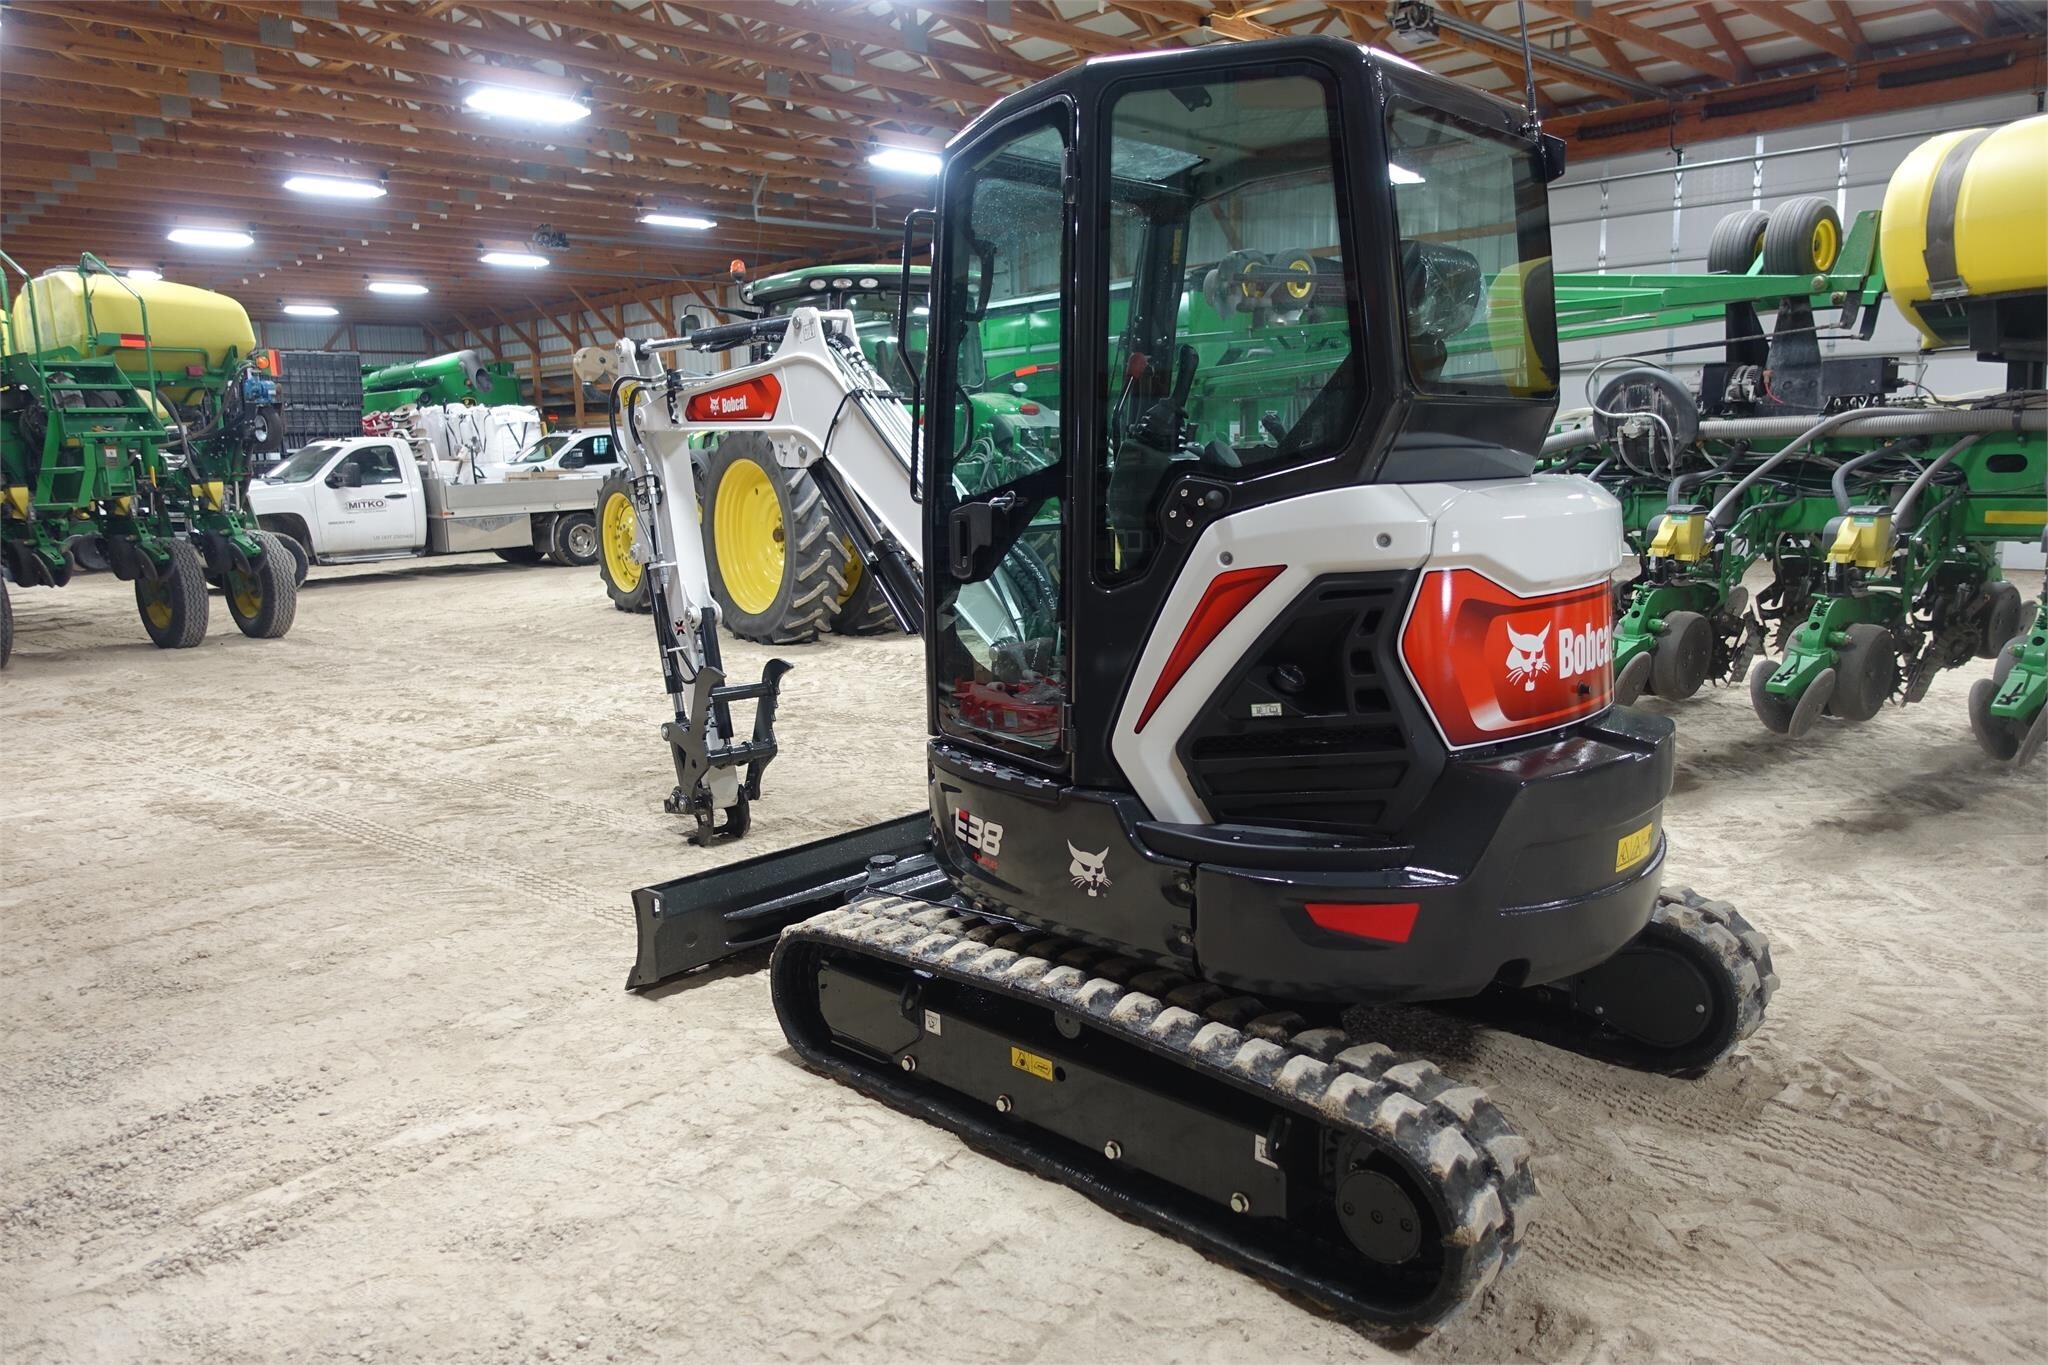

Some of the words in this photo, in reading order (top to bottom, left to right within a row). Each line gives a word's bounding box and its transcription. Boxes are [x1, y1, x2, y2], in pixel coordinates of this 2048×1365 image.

[721, 395, 748, 413] Bobcat
[348, 500, 384, 510] MITKO
[955, 807, 1004, 857] E38
